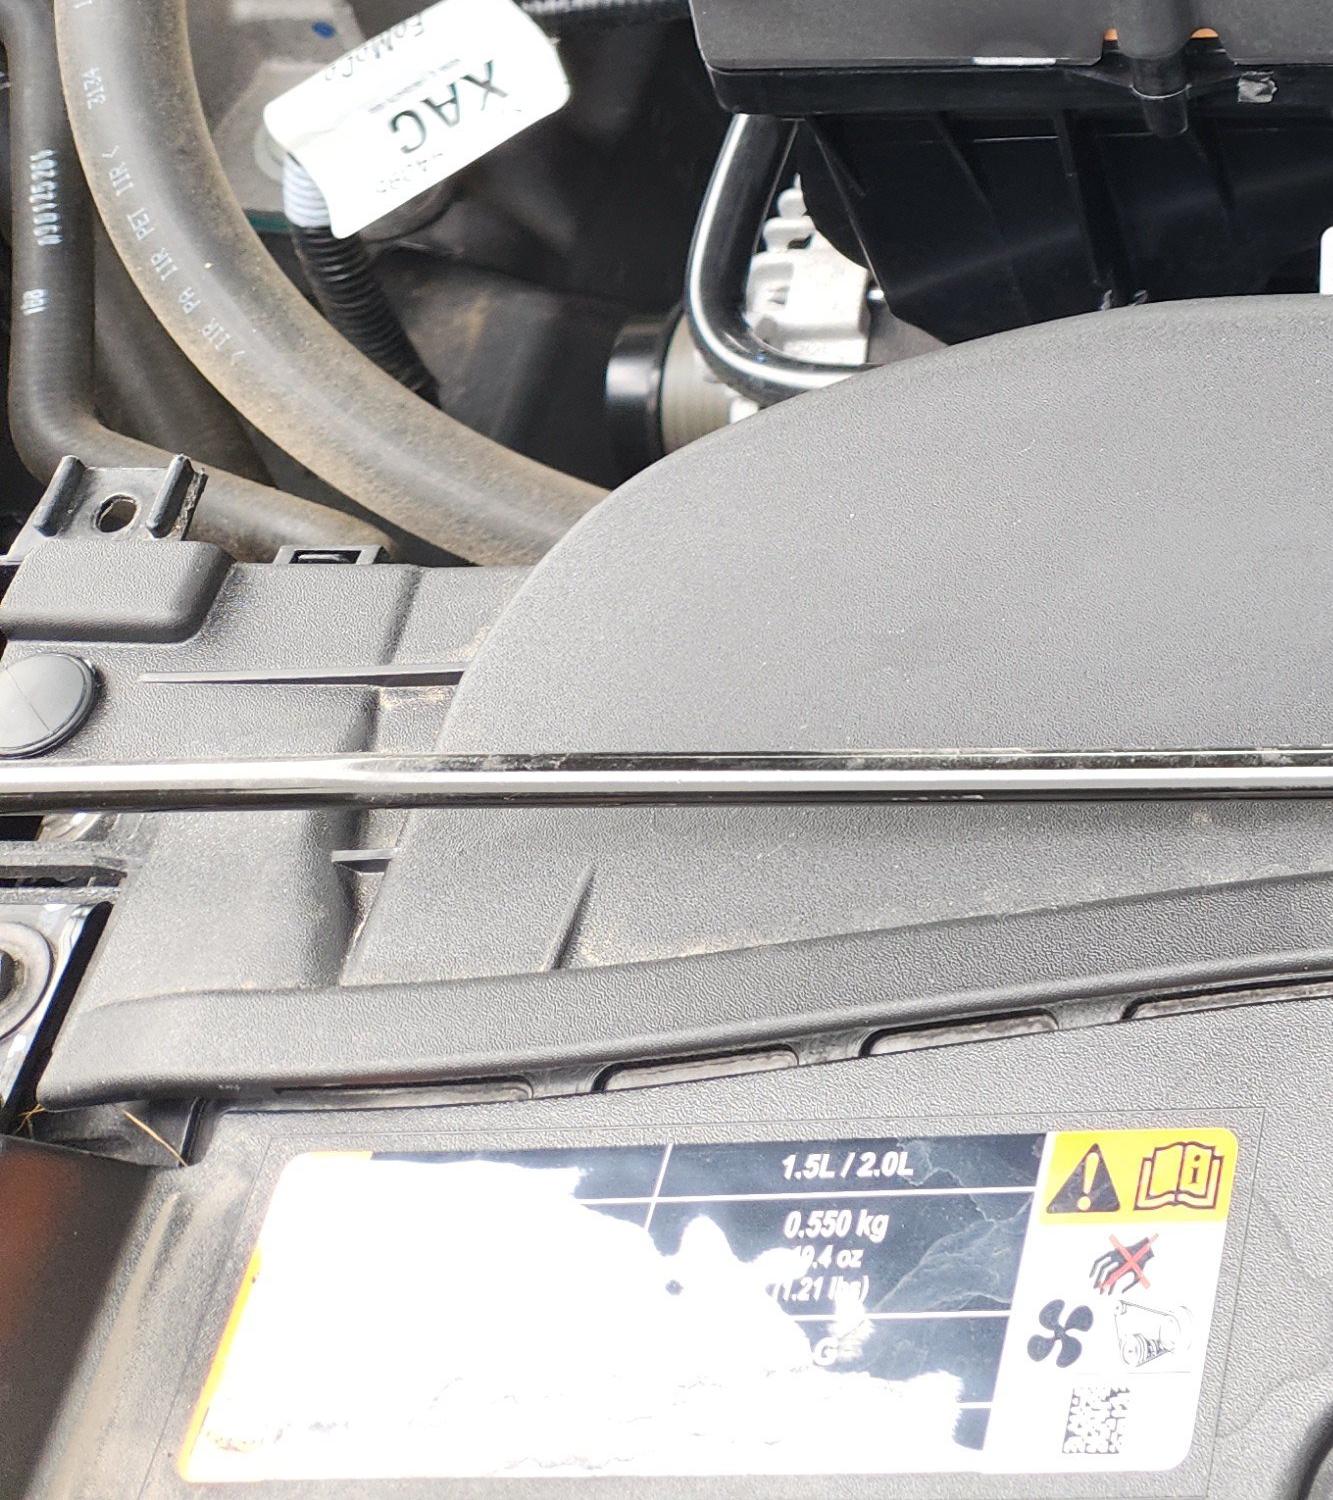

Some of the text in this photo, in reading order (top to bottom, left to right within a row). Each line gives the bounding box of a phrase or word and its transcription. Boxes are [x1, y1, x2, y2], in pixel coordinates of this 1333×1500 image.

[324, 12, 426, 82] FoMoCo
[390, 59, 509, 154] XAC
[126, 207, 156, 241] PET
[178, 286, 201, 315] PA
[781, 1150, 914, 1180] 1.5L / 2.0L
[784, 1208, 889, 1243] 0.550 kg
[836, 1249, 864, 1269] oz
